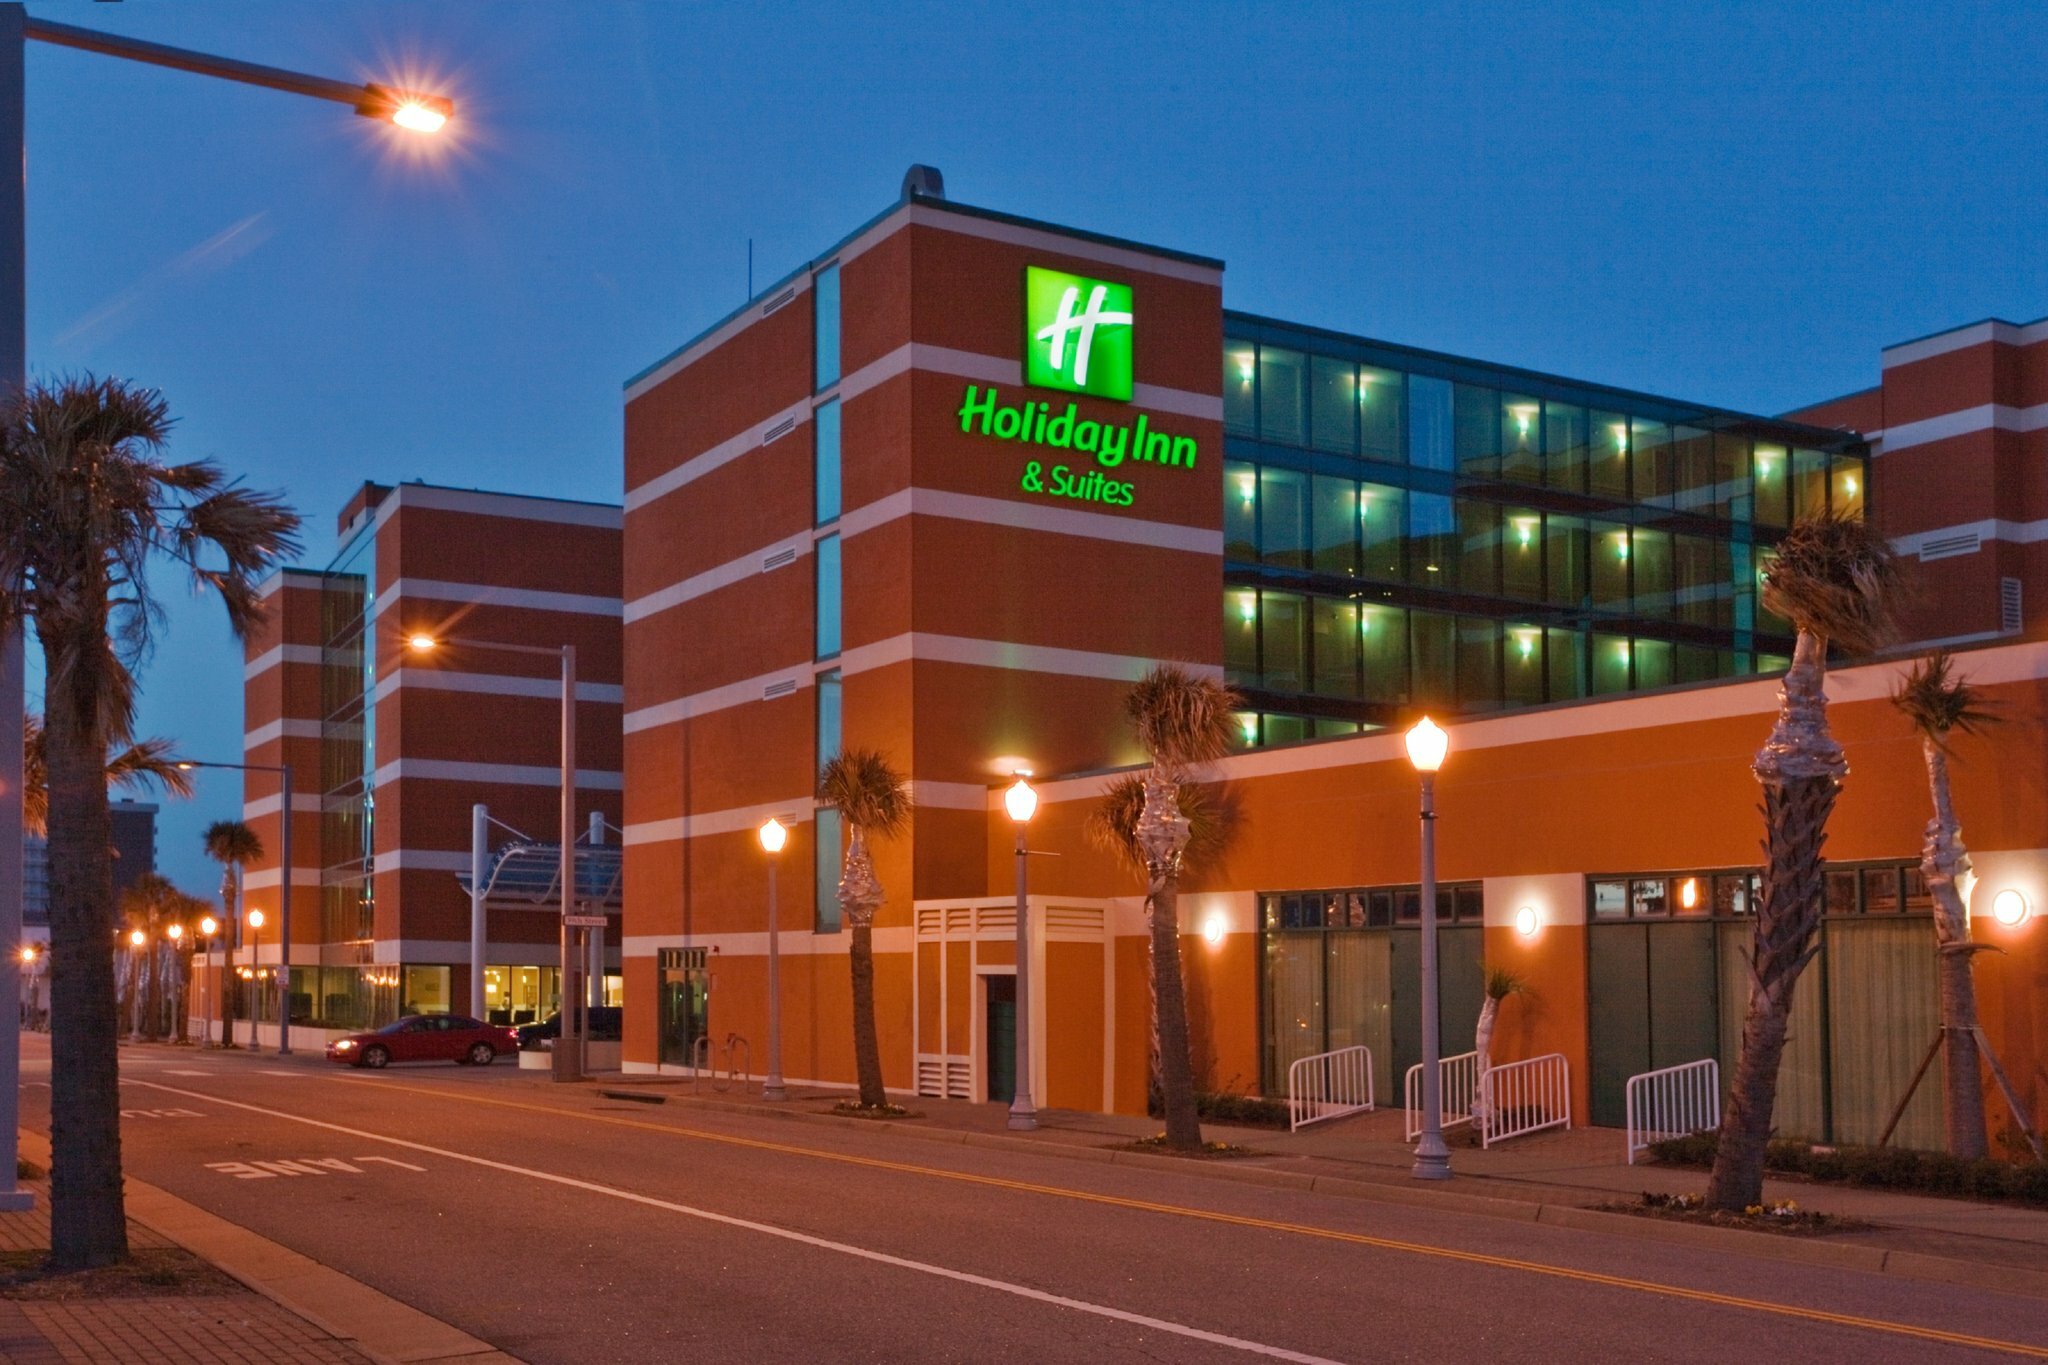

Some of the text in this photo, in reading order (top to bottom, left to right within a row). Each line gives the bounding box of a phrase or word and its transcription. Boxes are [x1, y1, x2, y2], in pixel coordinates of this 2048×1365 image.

[958, 385, 1197, 468] Holiday Inn
[1021, 461, 1134, 506] & Suites
[204, 1156, 428, 1179] LANE
